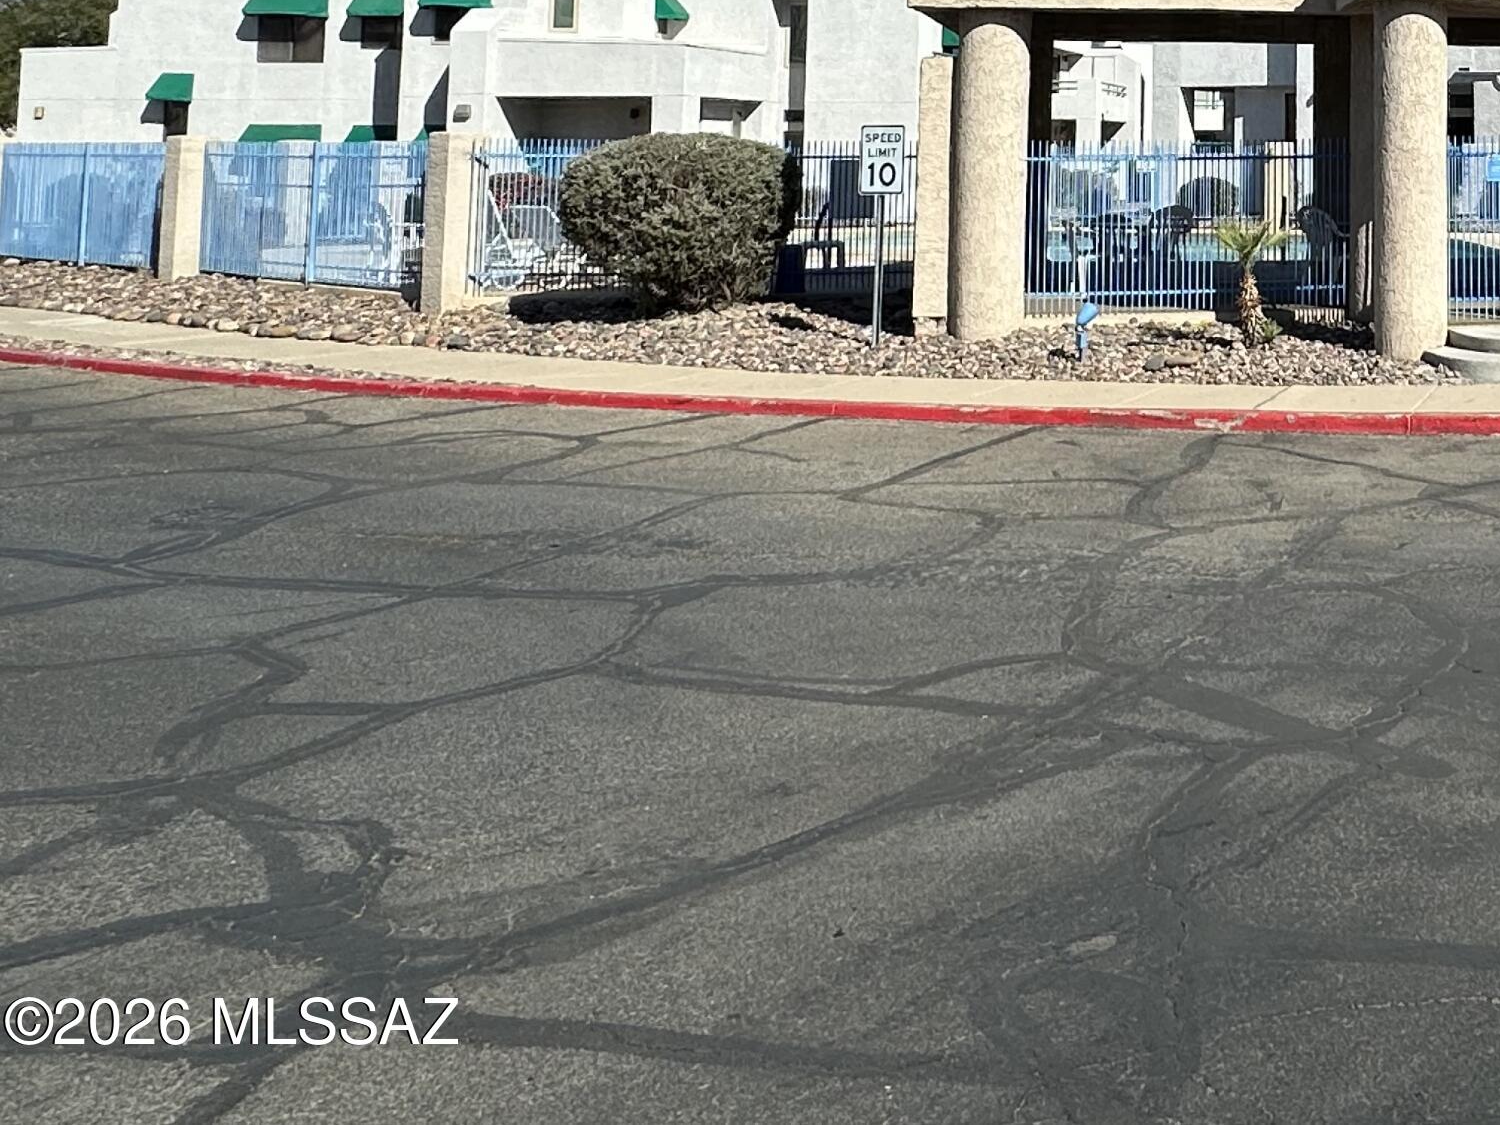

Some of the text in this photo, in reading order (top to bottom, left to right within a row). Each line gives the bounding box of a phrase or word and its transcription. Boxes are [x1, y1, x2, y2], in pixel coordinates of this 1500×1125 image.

[865, 133, 902, 143] SPEED
[867, 148, 897, 158] LIMIT
[867, 162, 896, 187] 10
